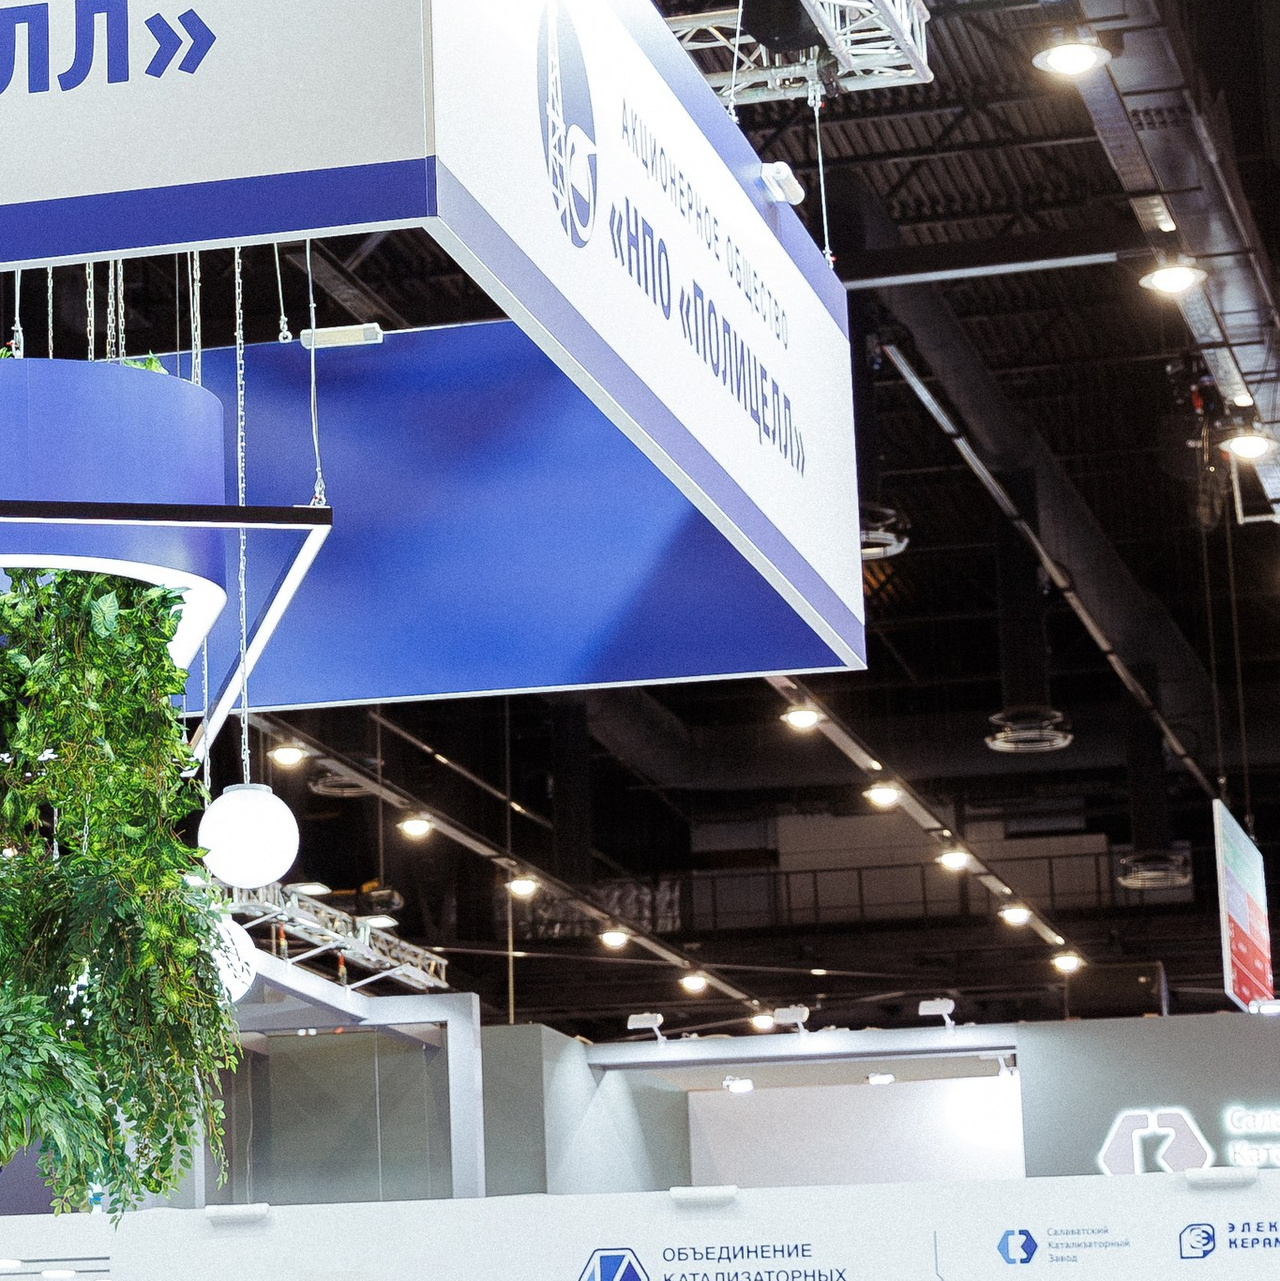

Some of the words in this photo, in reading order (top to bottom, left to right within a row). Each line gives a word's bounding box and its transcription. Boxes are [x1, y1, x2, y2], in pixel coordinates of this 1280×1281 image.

[622, 98, 719, 261] АКЦИОНЕРНОЕ
[726, 235, 788, 350] ОБЩЕСТВО
[609, 196, 671, 320] «НПО
[679, 278, 805, 478] «ПОЛИЦЕЛЛ»
[662, 1243, 813, 1263] ОБЪЕДИНЕНИЕ
[1047, 1225, 1110, 1237] Салаватский
